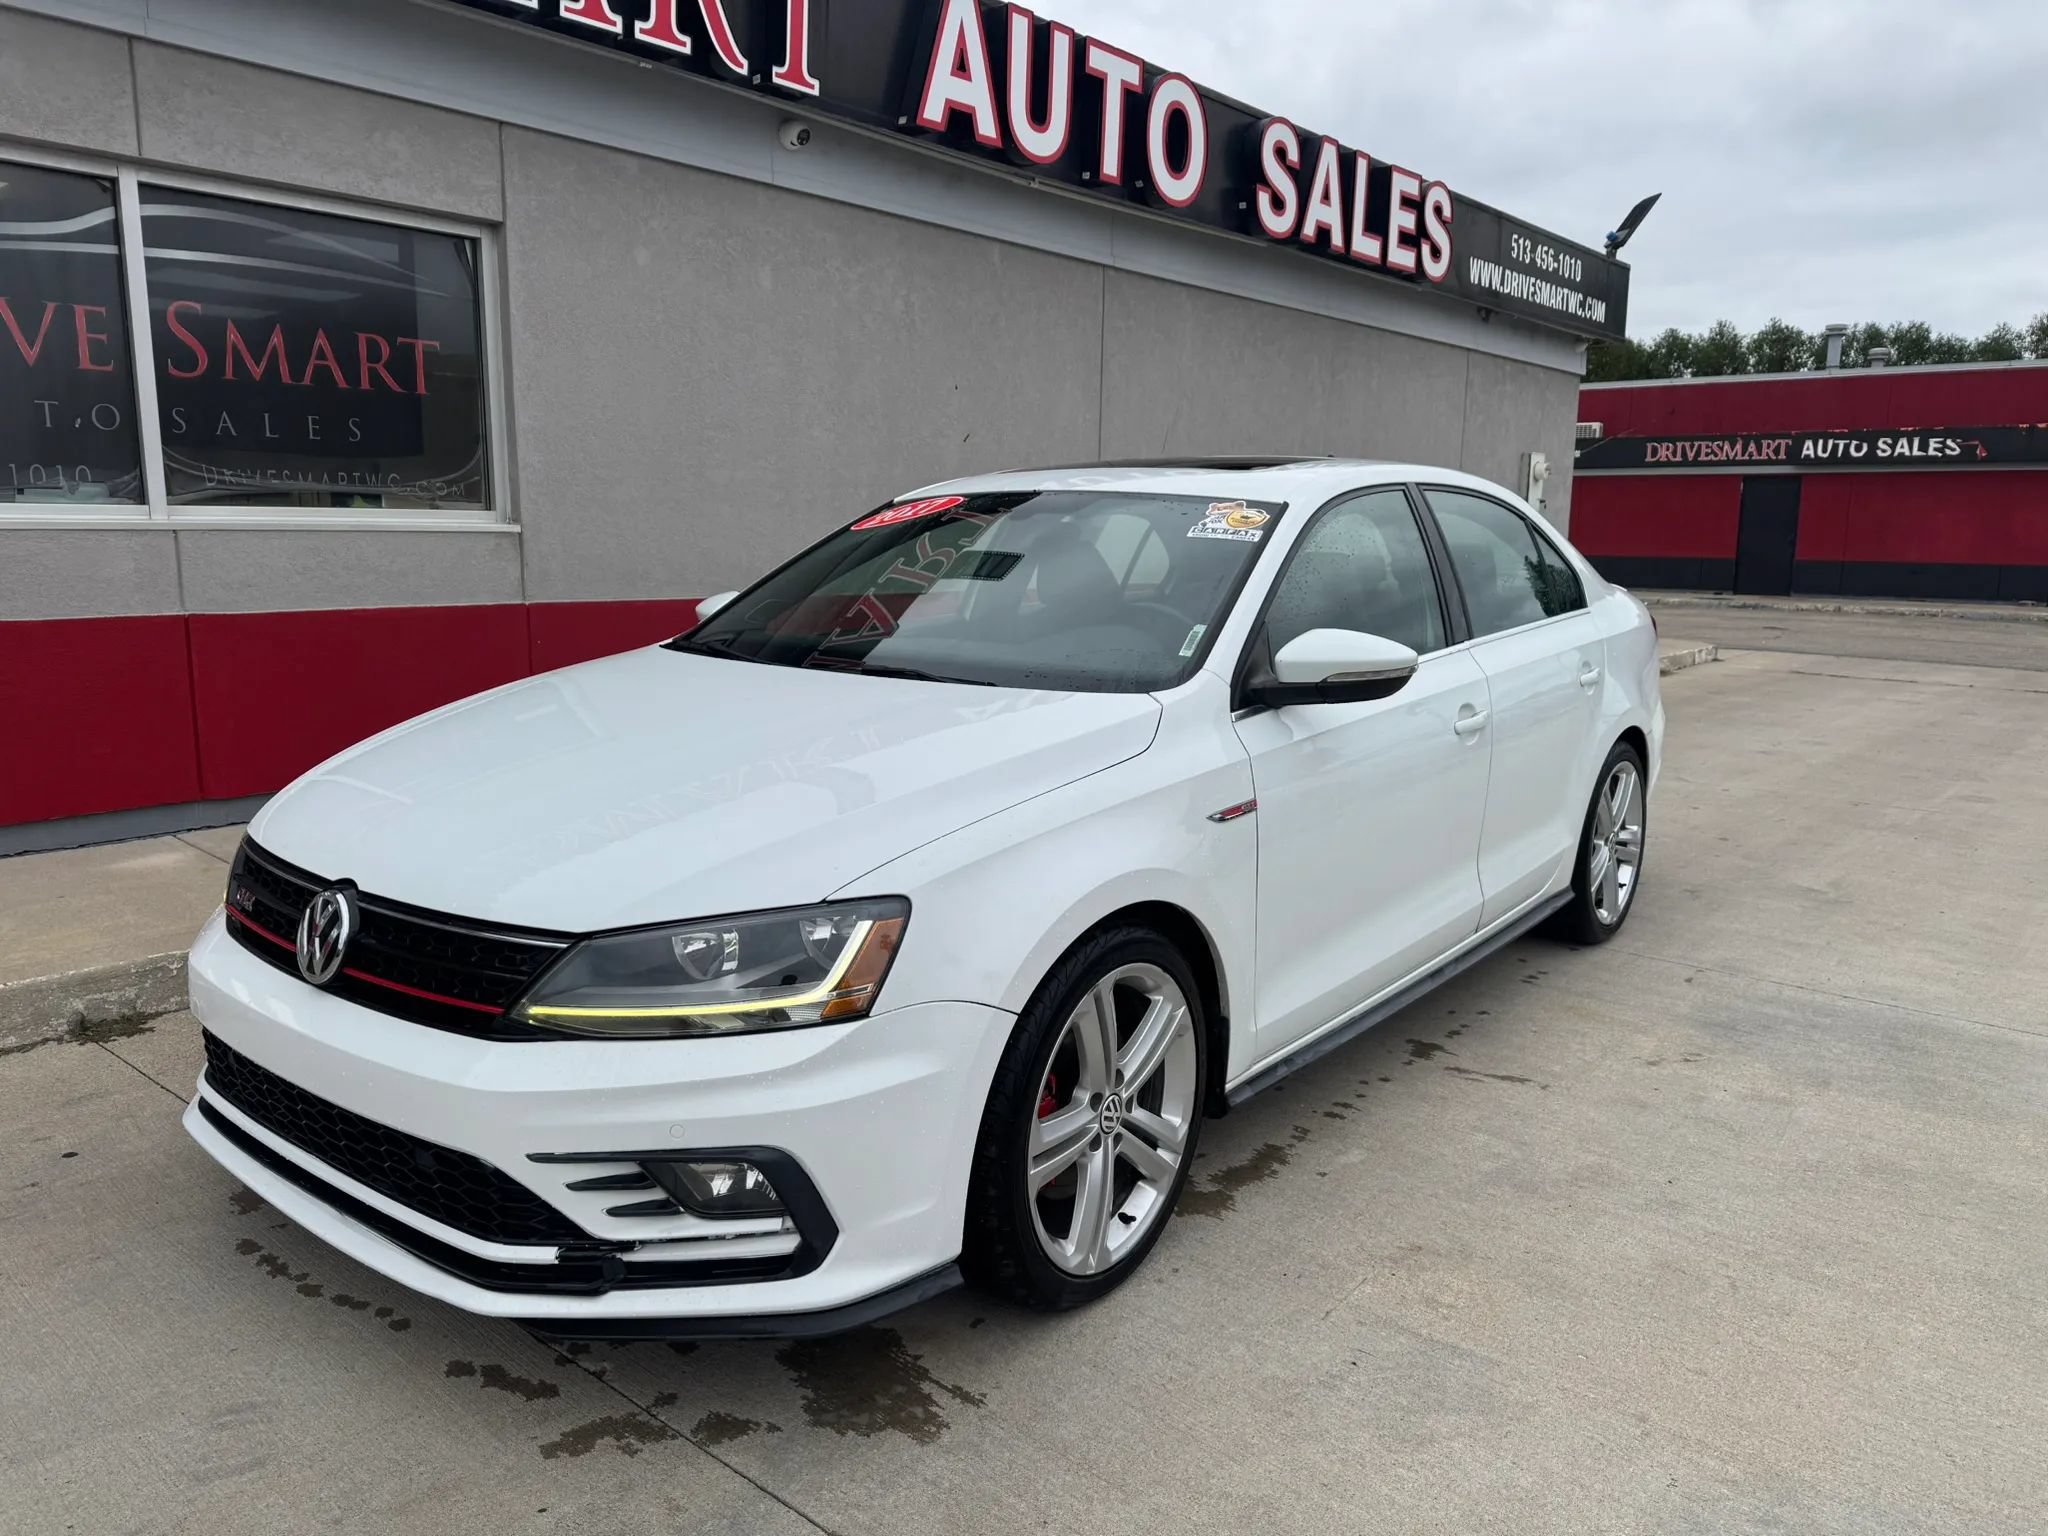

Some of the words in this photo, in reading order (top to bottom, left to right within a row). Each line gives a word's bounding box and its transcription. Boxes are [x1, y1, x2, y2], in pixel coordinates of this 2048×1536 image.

[916, 0, 1208, 208] AUTO
[1256, 116, 1454, 284] SALES
[1511, 233, 1582, 283] 513-456-1010
[1470, 256, 1606, 324] WWW.DRIVESMARTWC.COM
[166, 300, 441, 396] SMART
[172, 406, 363, 442] SALES
[1644, 438, 1792, 463] DRIVESMART
[1800, 438, 1868, 460] AUTO
[1876, 436, 1962, 458] SALES
